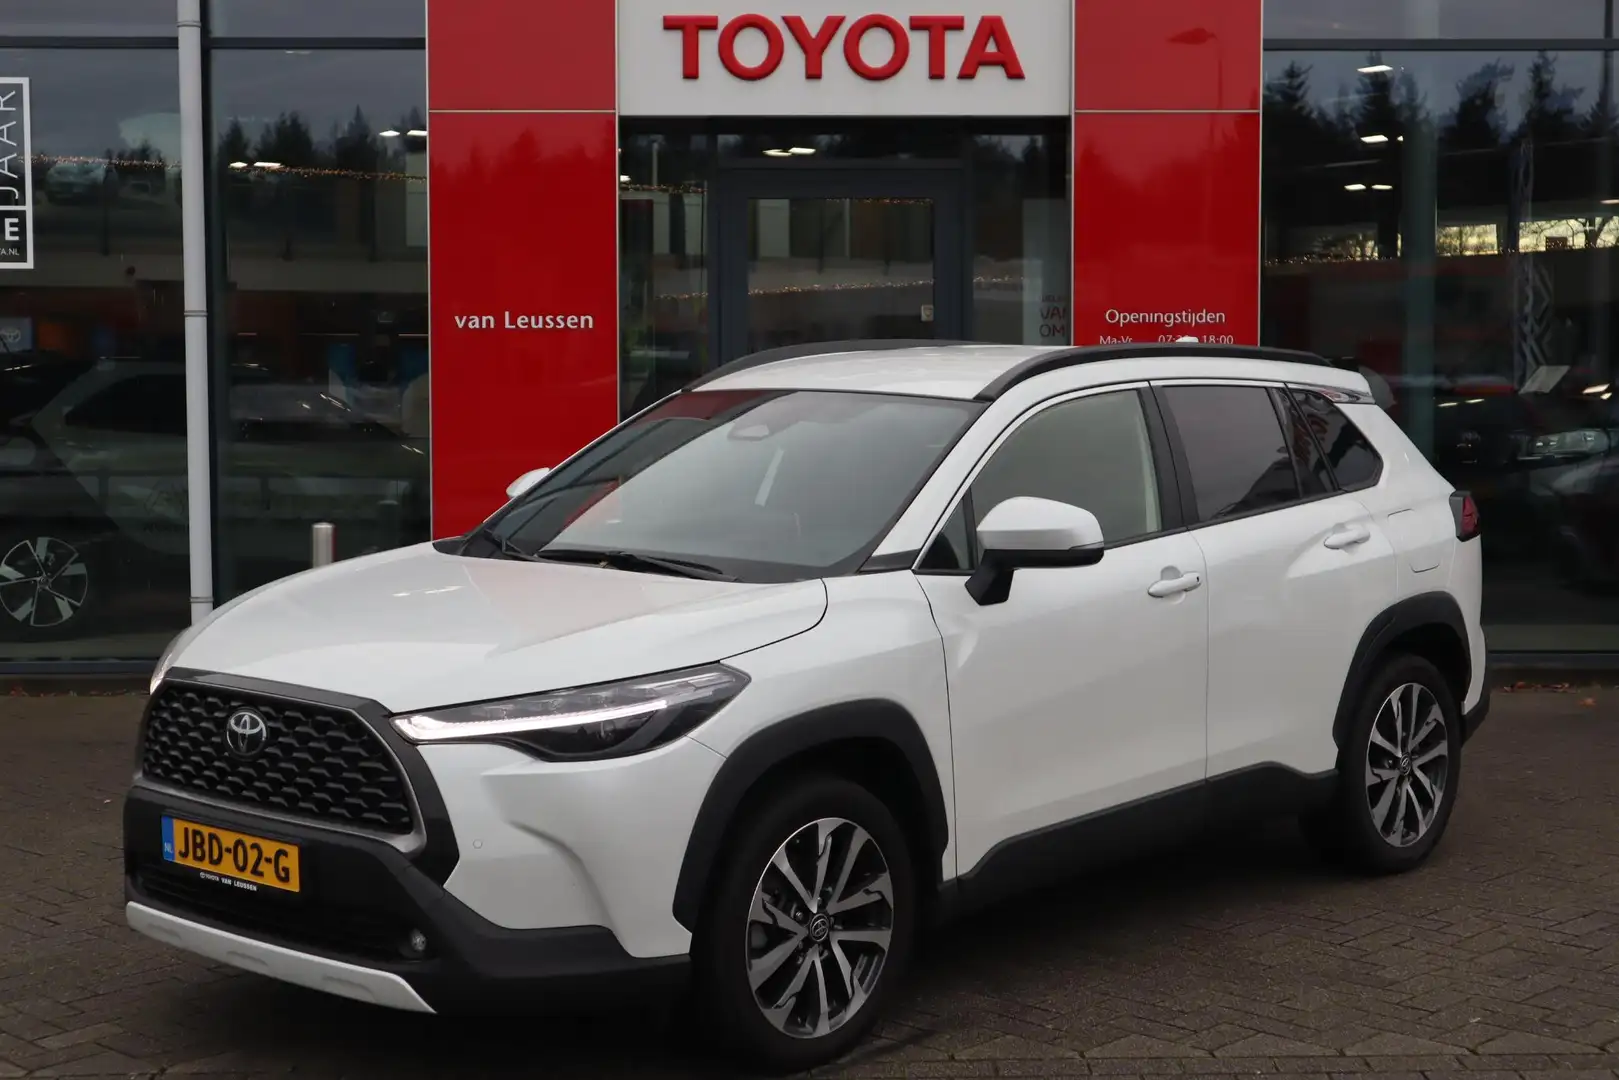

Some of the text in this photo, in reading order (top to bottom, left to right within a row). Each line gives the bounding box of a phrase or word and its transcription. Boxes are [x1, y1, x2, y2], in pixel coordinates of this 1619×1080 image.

[663, 13, 1026, 81] TOYOTA
[0, 247, 20, 256] A.NL
[454, 310, 594, 329] van Leussen
[1105, 309, 1226, 327] Openingstijden
[1099, 334, 1234, 345] Ma-Vr 07: 18:00
[178, 826, 290, 883] JBD-02-G
[221, 877, 232, 886] VAN
[233, 880, 258, 892] LEUSSEN
